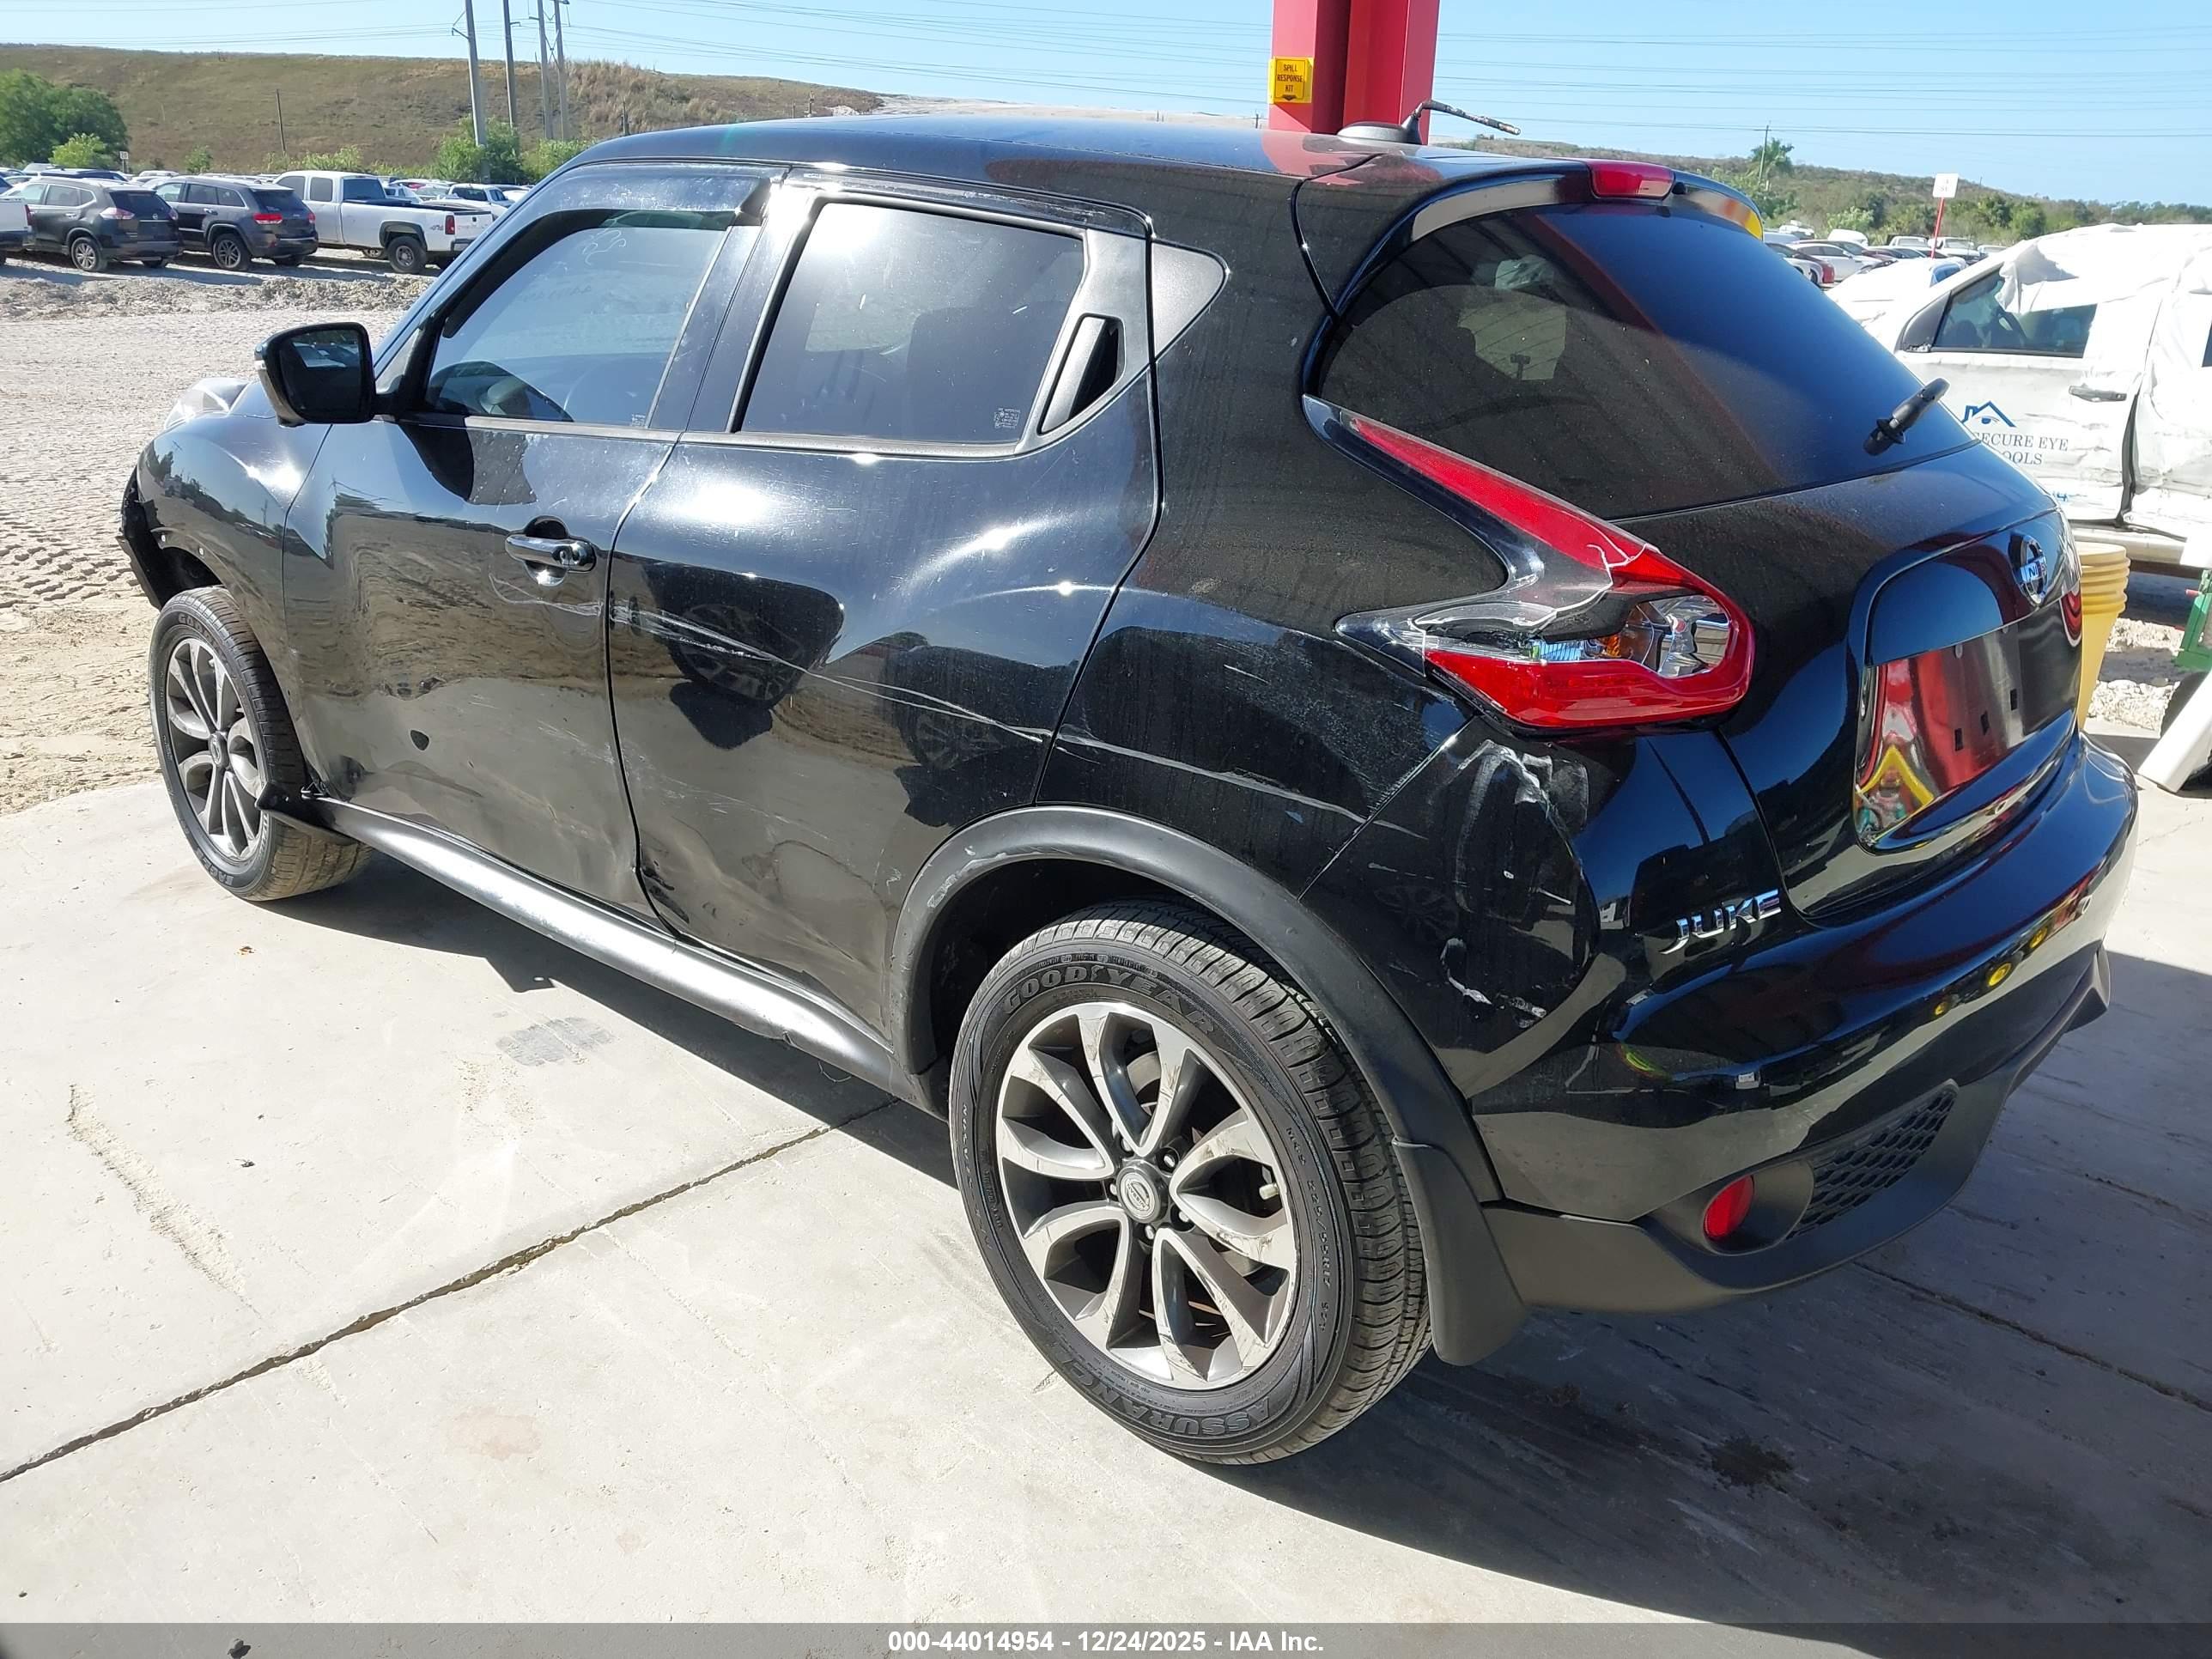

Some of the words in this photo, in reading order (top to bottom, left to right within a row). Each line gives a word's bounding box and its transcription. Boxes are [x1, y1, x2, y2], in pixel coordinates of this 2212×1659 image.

[1277, 74, 1304, 83] RESPONSE
[2038, 436, 2069, 452] EYE
[2002, 450, 2043, 465] OOLS
[1658, 888, 1782, 955] JUKE
[1002, 964, 1215, 1032] GOODYEAR
